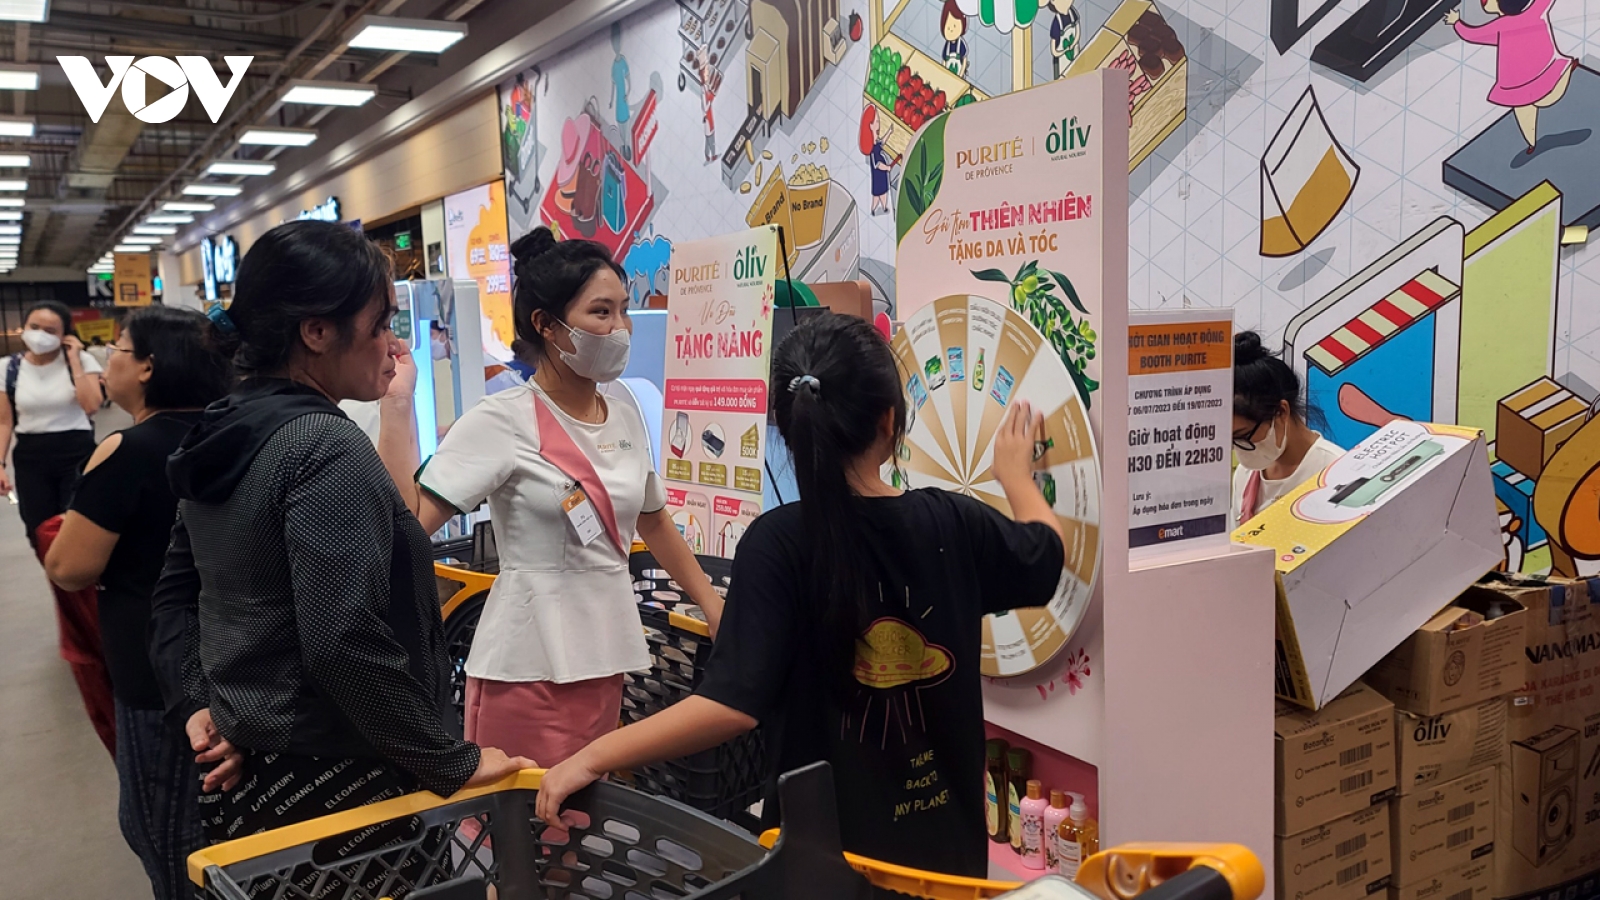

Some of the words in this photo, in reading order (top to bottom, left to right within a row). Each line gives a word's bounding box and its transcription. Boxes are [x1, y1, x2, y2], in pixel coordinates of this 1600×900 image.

[956, 136, 1023, 169] PURITÉ
[1045, 115, 1091, 154] ôliv
[965, 171, 974, 181] DE
[791, 201, 801, 212] No
[803, 196, 823, 210] Brand
[970, 201, 1024, 232] THIÊN
[1028, 191, 1092, 225] NHIÊN
[949, 239, 982, 265] TẶNG
[986, 239, 1004, 257] DA
[1007, 231, 1026, 256] VÀ
[1029, 228, 1058, 254] TÓC
[675, 260, 720, 284] PURITÉ
[733, 245, 767, 280] ôliv
[680, 288, 686, 296] DE
[675, 327, 713, 366] TẶNG
[717, 324, 763, 358] NÀNG
[1147, 333, 1170, 347] GIAN
[1173, 331, 1198, 349] HOẠT
[1200, 328, 1224, 347] ĐỘNG
[1140, 354, 1171, 368] BOOTH
[1174, 352, 1207, 366] PURITE
[1134, 389, 1162, 400] CHƯƠNG
[1164, 386, 1183, 397] TRÌNH
[1184, 385, 1193, 396] ÁP
[1194, 384, 1211, 396] DỤNG
[1133, 403, 1171, 415] 06/07/2023
[1187, 398, 1222, 410] 19/07/2023
[1128, 428, 1150, 446] Giờ
[1154, 425, 1181, 446] hoạt
[1185, 422, 1215, 443] động
[1353, 429, 1399, 460] ELECTRIC
[1369, 445, 1392, 459] HOT
[1389, 432, 1410, 446] POT
[1156, 445, 1181, 469] ĐẾN
[1185, 446, 1223, 465] 22H30
[1132, 505, 1140, 515] Áp
[1142, 504, 1157, 515] dụng
[1183, 498, 1198, 508] trong
[1200, 496, 1214, 506] ngày
[1133, 493, 1144, 501] Lưu
[1158, 525, 1183, 539] emart
[1540, 671, 1580, 690] KARAOKE
[1413, 716, 1452, 742] ôliv
[274, 783, 315, 816] ELEGANC
[314, 769, 335, 786] AND
[324, 777, 366, 810] ELEGANC
[905, 775, 931, 790] BACK
[894, 801, 911, 816] MY
[914, 789, 949, 812] PLANET
